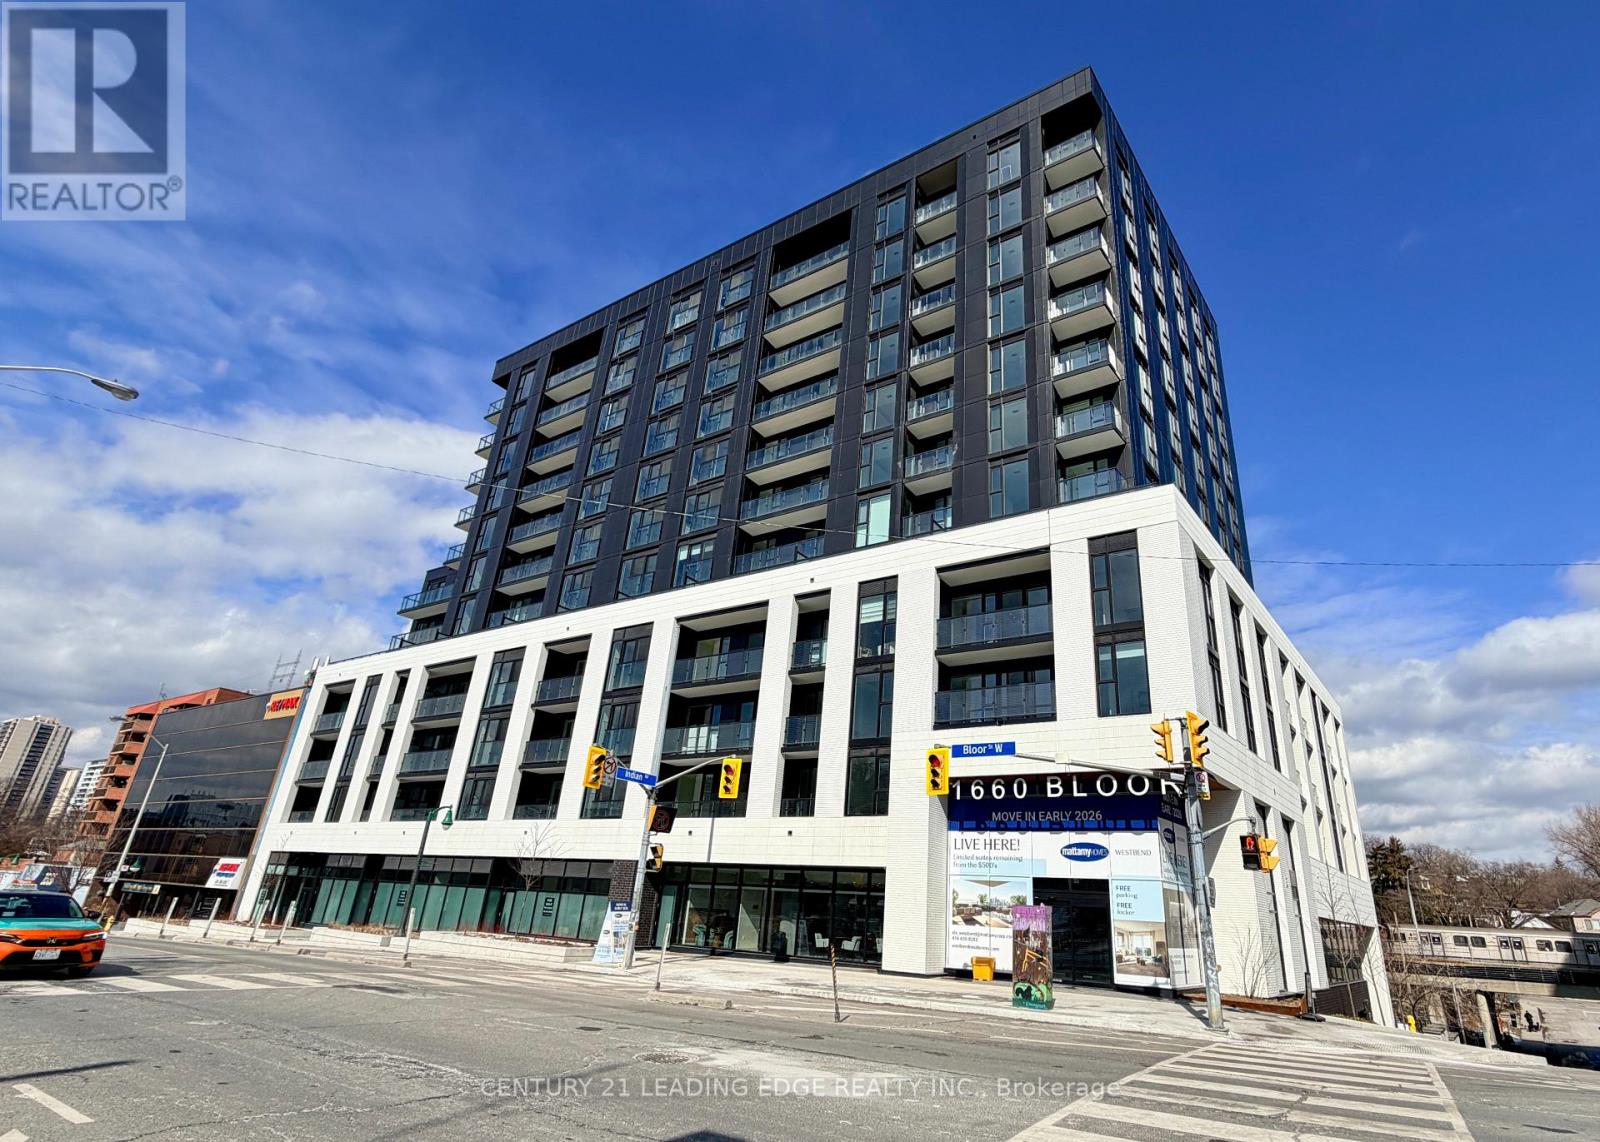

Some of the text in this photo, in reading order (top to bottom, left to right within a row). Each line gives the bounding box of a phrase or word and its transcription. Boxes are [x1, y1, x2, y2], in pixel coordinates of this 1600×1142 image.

[962, 745, 987, 755] Bloor
[994, 743, 1003, 753] W
[624, 770, 643, 780] Indian
[951, 777, 1027, 801] 1660
[991, 810, 1102, 822] MOVE IN EARLY 2026
[954, 838, 1021, 852] LIVE HERE!
[1114, 848, 1152, 857] WESTBEND
[1115, 885, 1132, 893] FREE
[1116, 903, 1133, 911] FREE
